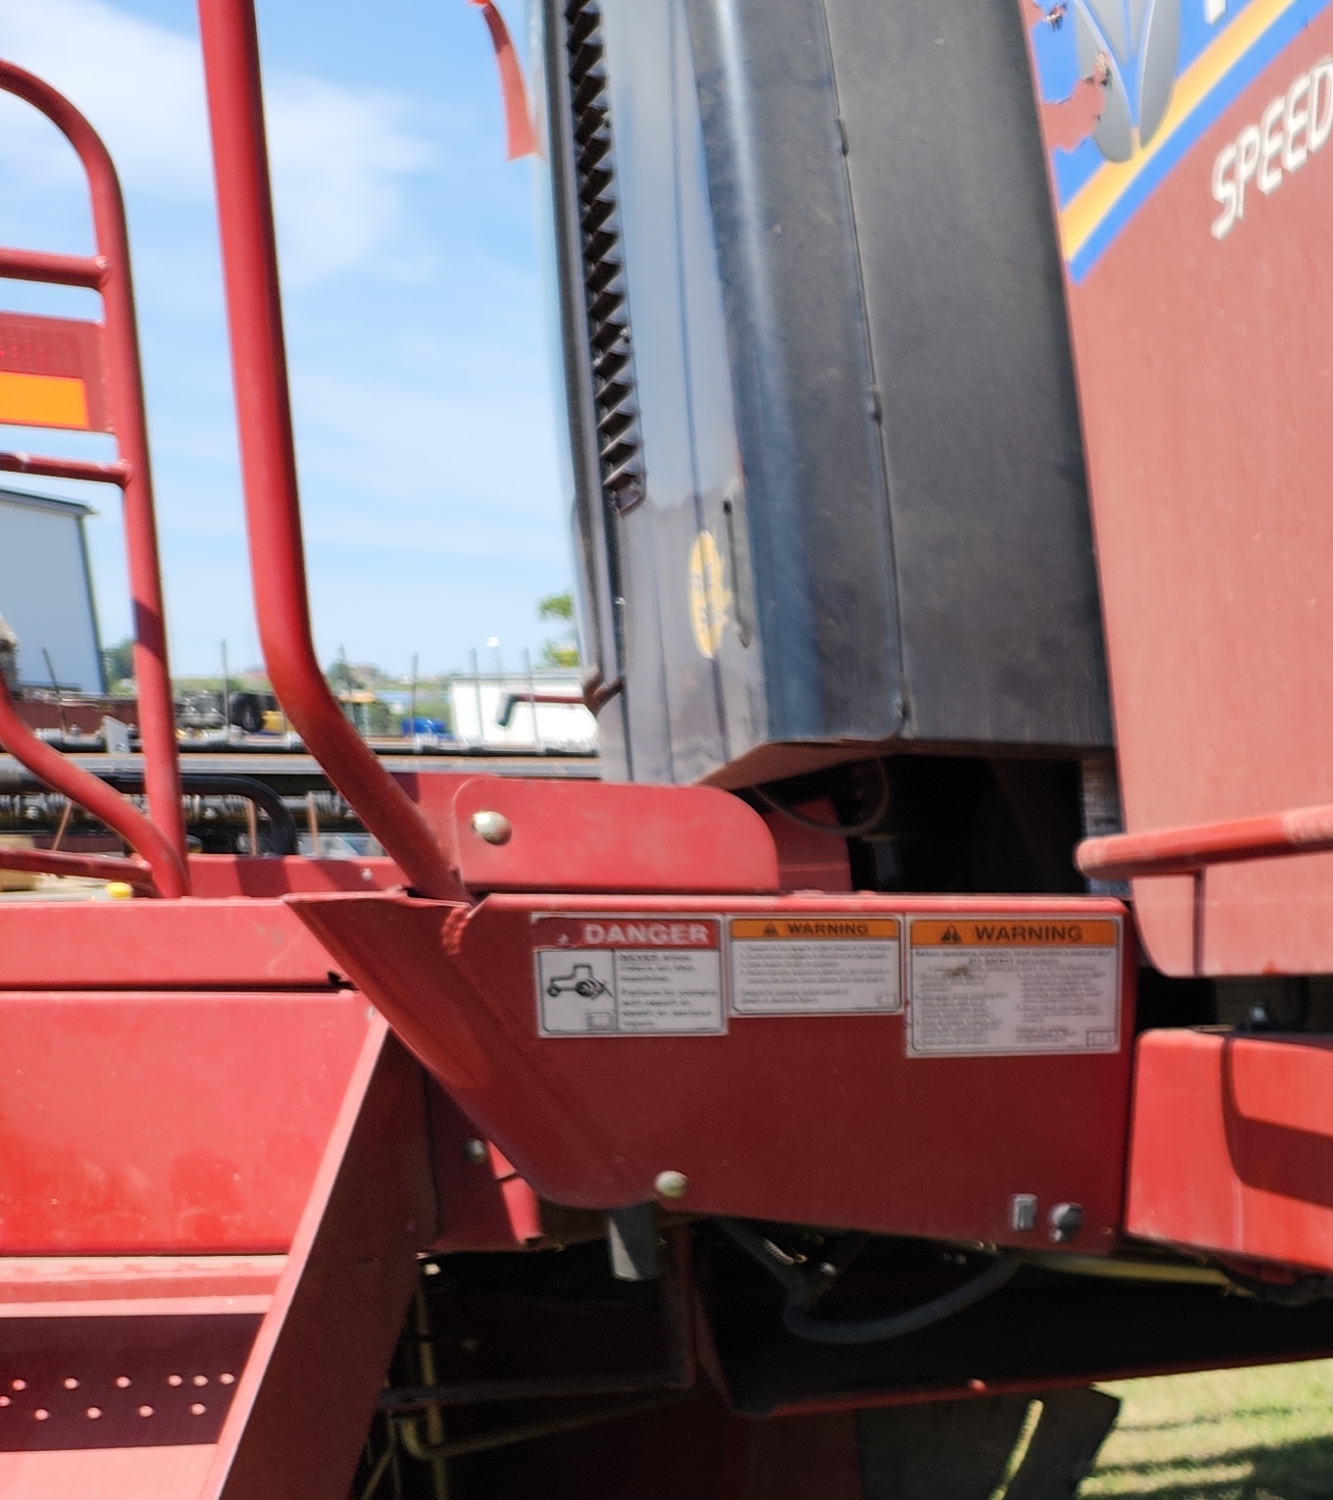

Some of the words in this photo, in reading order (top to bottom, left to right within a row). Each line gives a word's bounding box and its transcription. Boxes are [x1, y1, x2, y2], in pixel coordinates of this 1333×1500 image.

[583, 923, 709, 945] DANGER
[787, 922, 868, 936] WARNING
[974, 924, 1083, 942] WARNING
